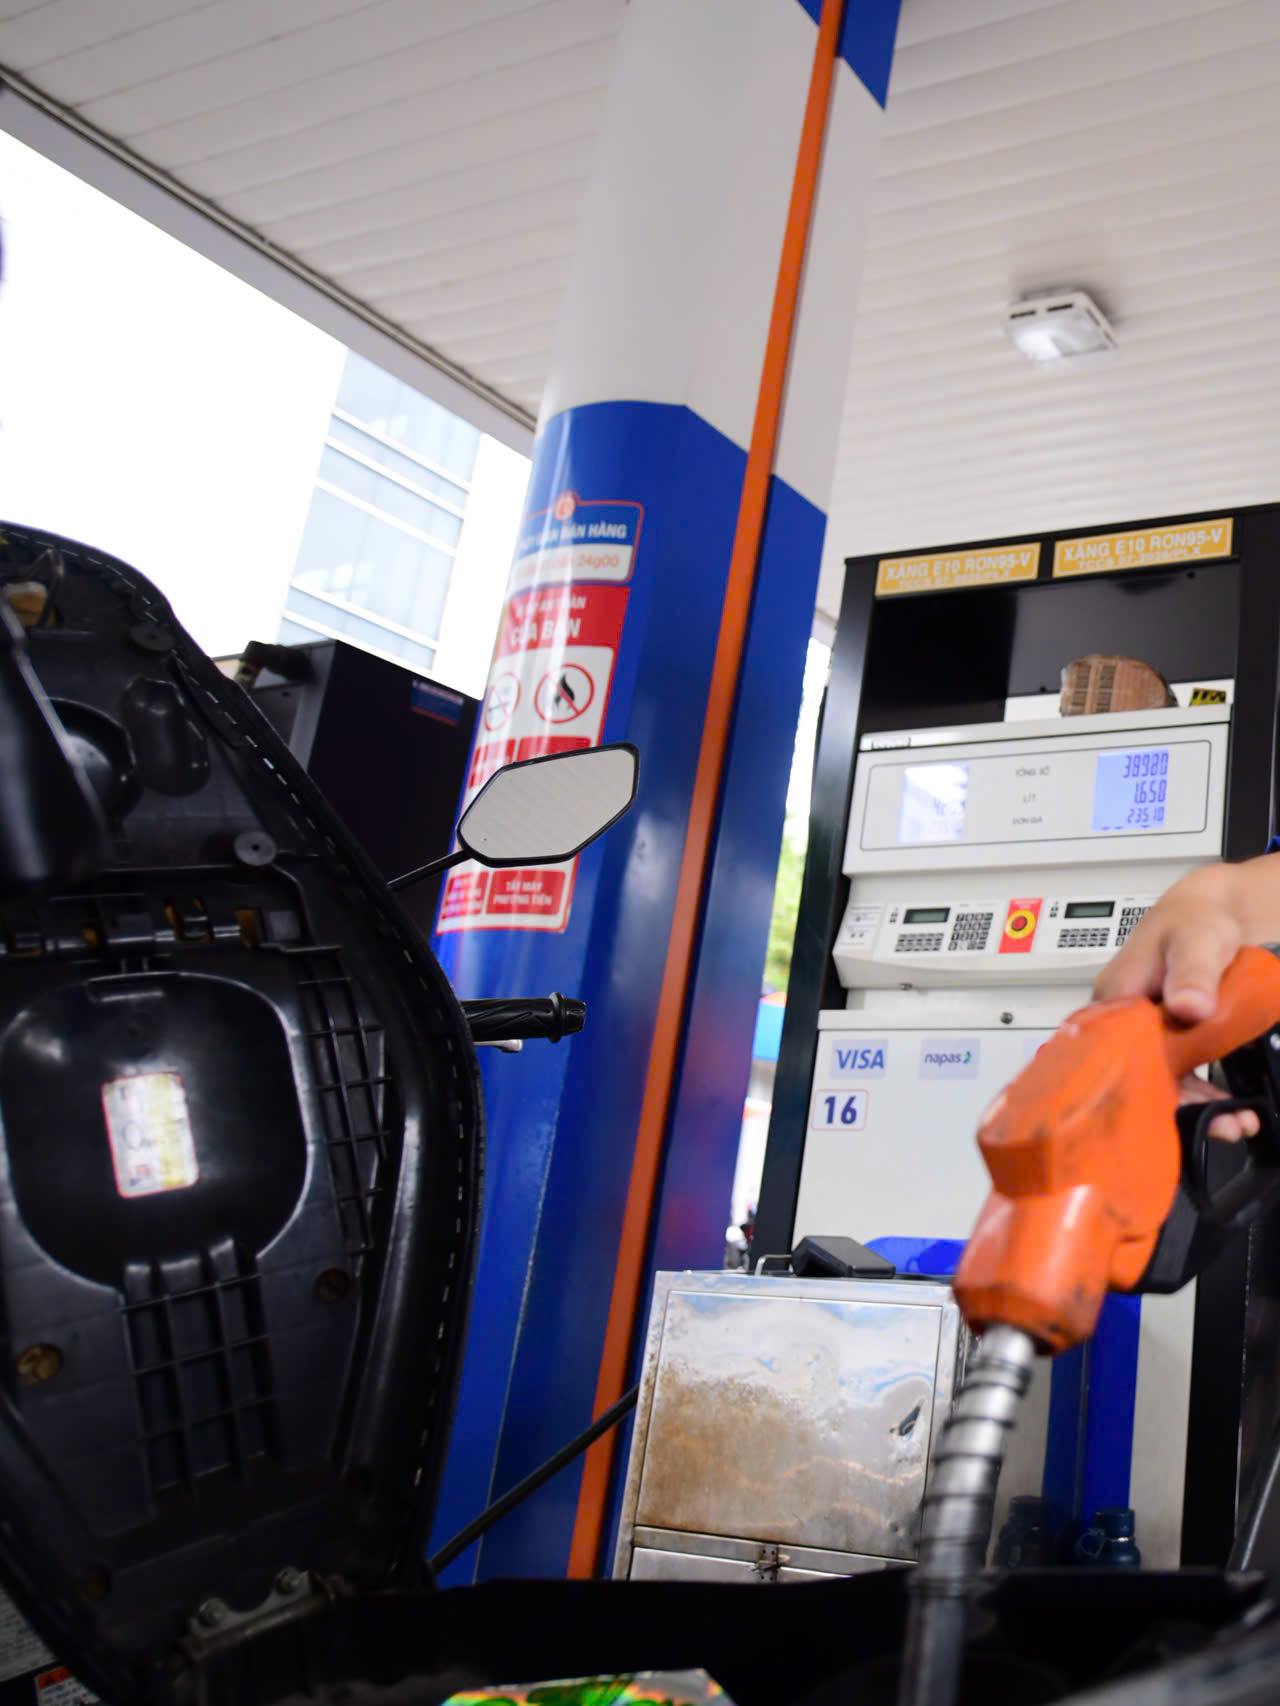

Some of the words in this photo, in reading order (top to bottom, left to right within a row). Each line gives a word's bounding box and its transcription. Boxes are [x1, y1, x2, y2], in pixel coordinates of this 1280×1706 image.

[588, 520, 628, 539] HÀNG
[1114, 538, 1145, 554] E10
[1150, 527, 1224, 548] RON95-V
[836, 1049, 885, 1069] VISA
[924, 1052, 962, 1067] napas
[824, 1095, 858, 1124] 16
